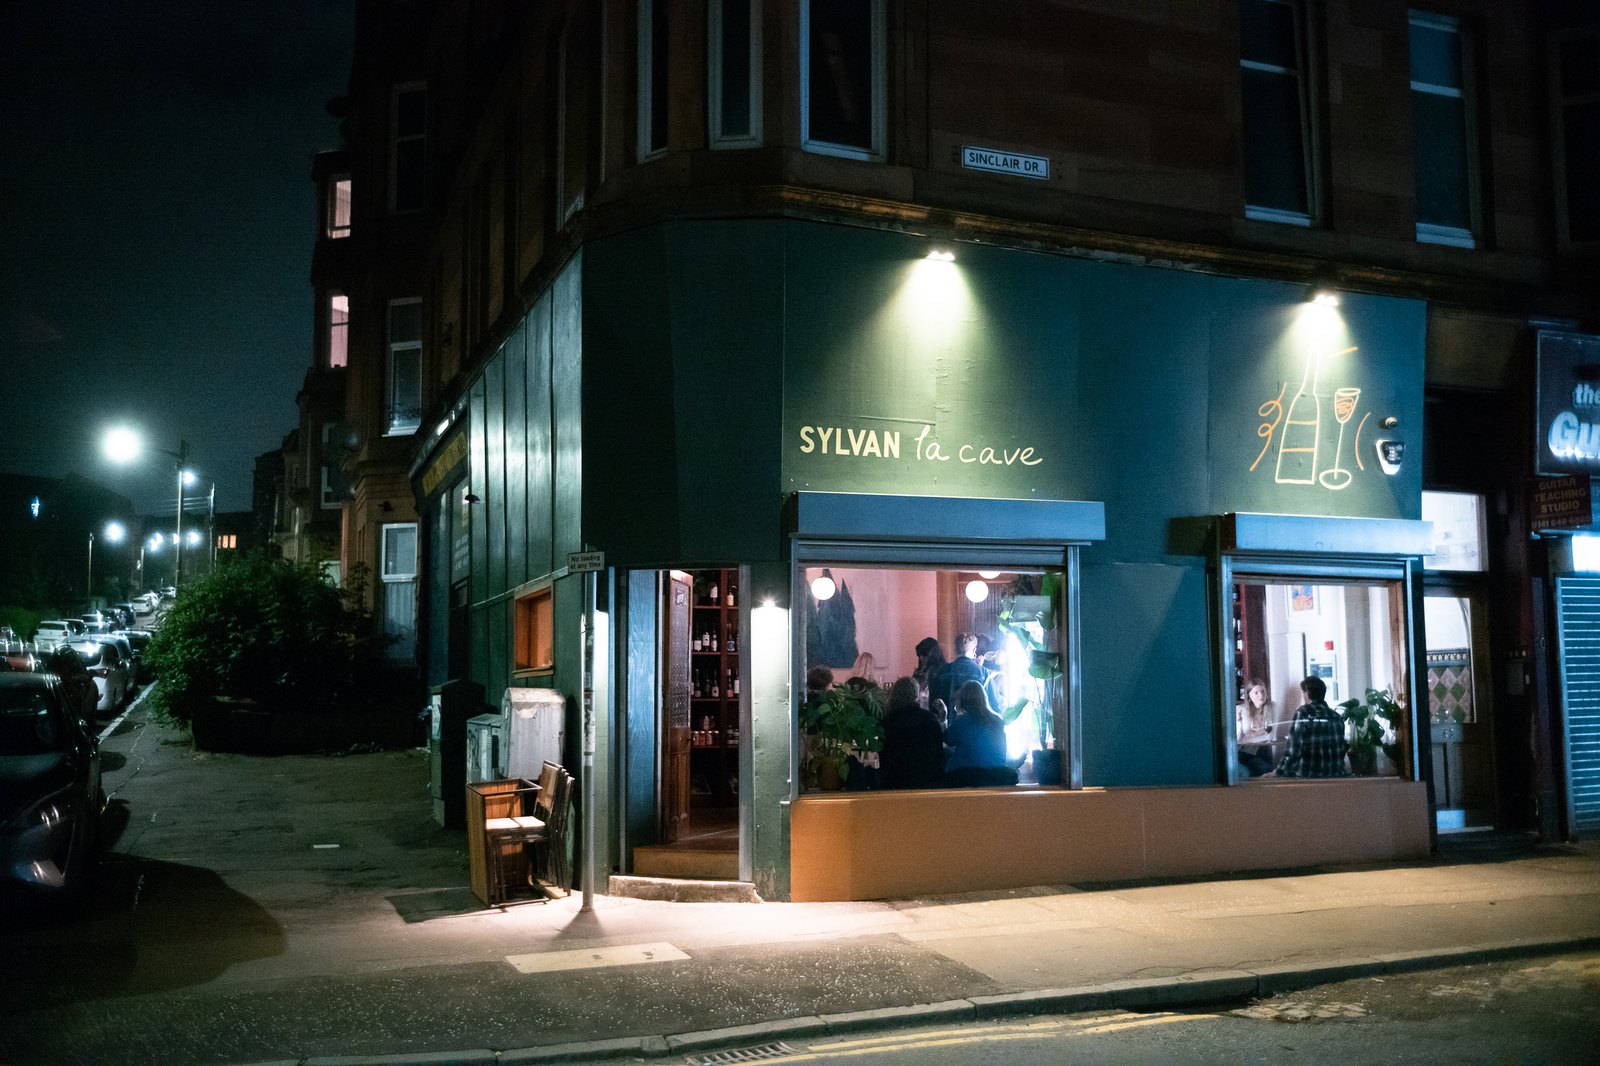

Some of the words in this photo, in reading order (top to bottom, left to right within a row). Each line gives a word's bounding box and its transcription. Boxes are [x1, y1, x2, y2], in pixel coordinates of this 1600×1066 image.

[969, 152, 1020, 170] SINCLAIR
[800, 425, 900, 458] SYLVAN
[914, 424, 950, 461] la
[958, 444, 1043, 466] cave
[1539, 478, 1576, 490] GUITAR
[1534, 488, 1586, 502] TEACHING
[1541, 500, 1580, 513] STUDIO
